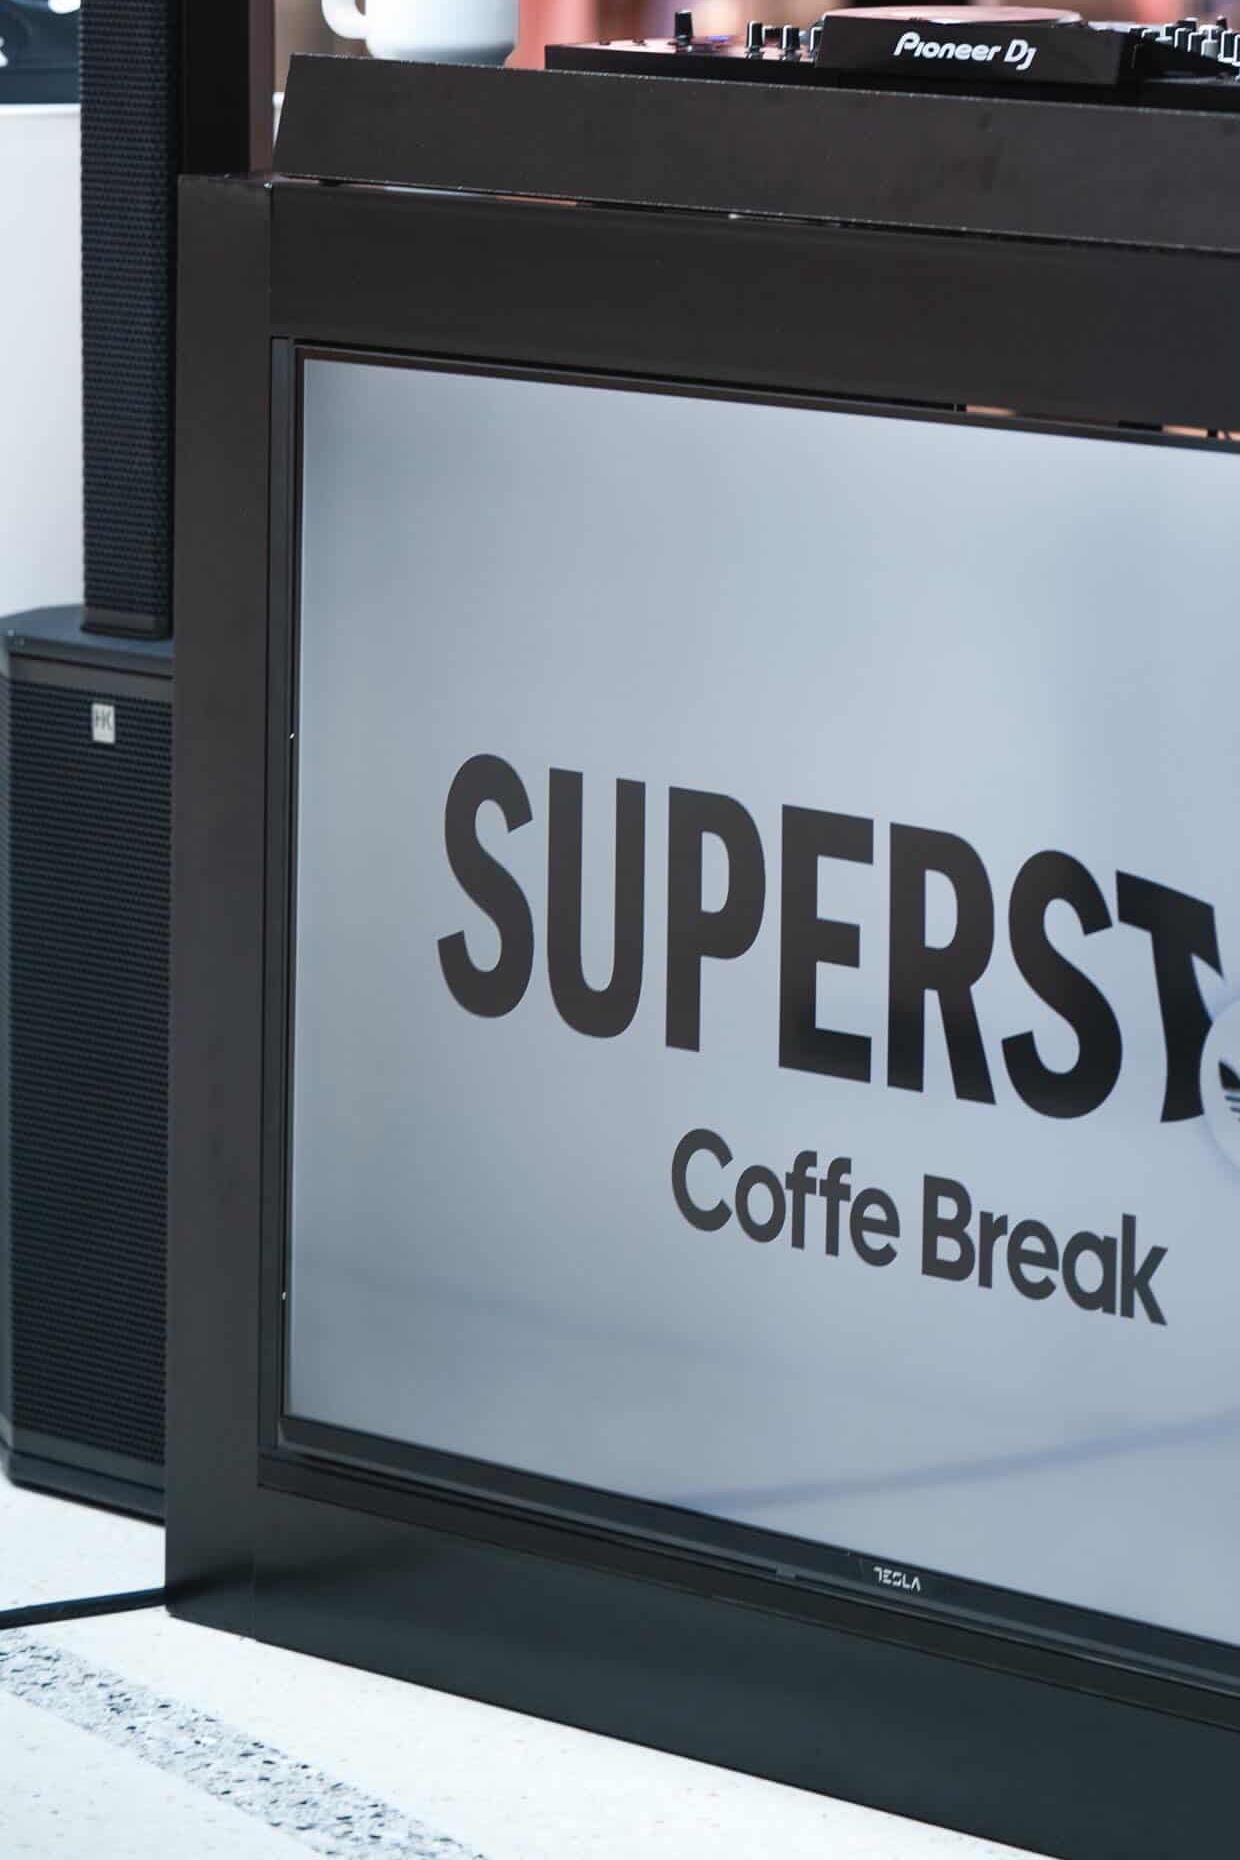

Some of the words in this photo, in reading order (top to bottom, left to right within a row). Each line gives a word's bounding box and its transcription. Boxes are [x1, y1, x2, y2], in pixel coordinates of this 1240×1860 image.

[893, 31, 1002, 61] Pioneer
[671, 1128, 901, 1268] Coffe
[921, 1173, 1168, 1326] Break
[873, 1566, 921, 1592] TESLA
